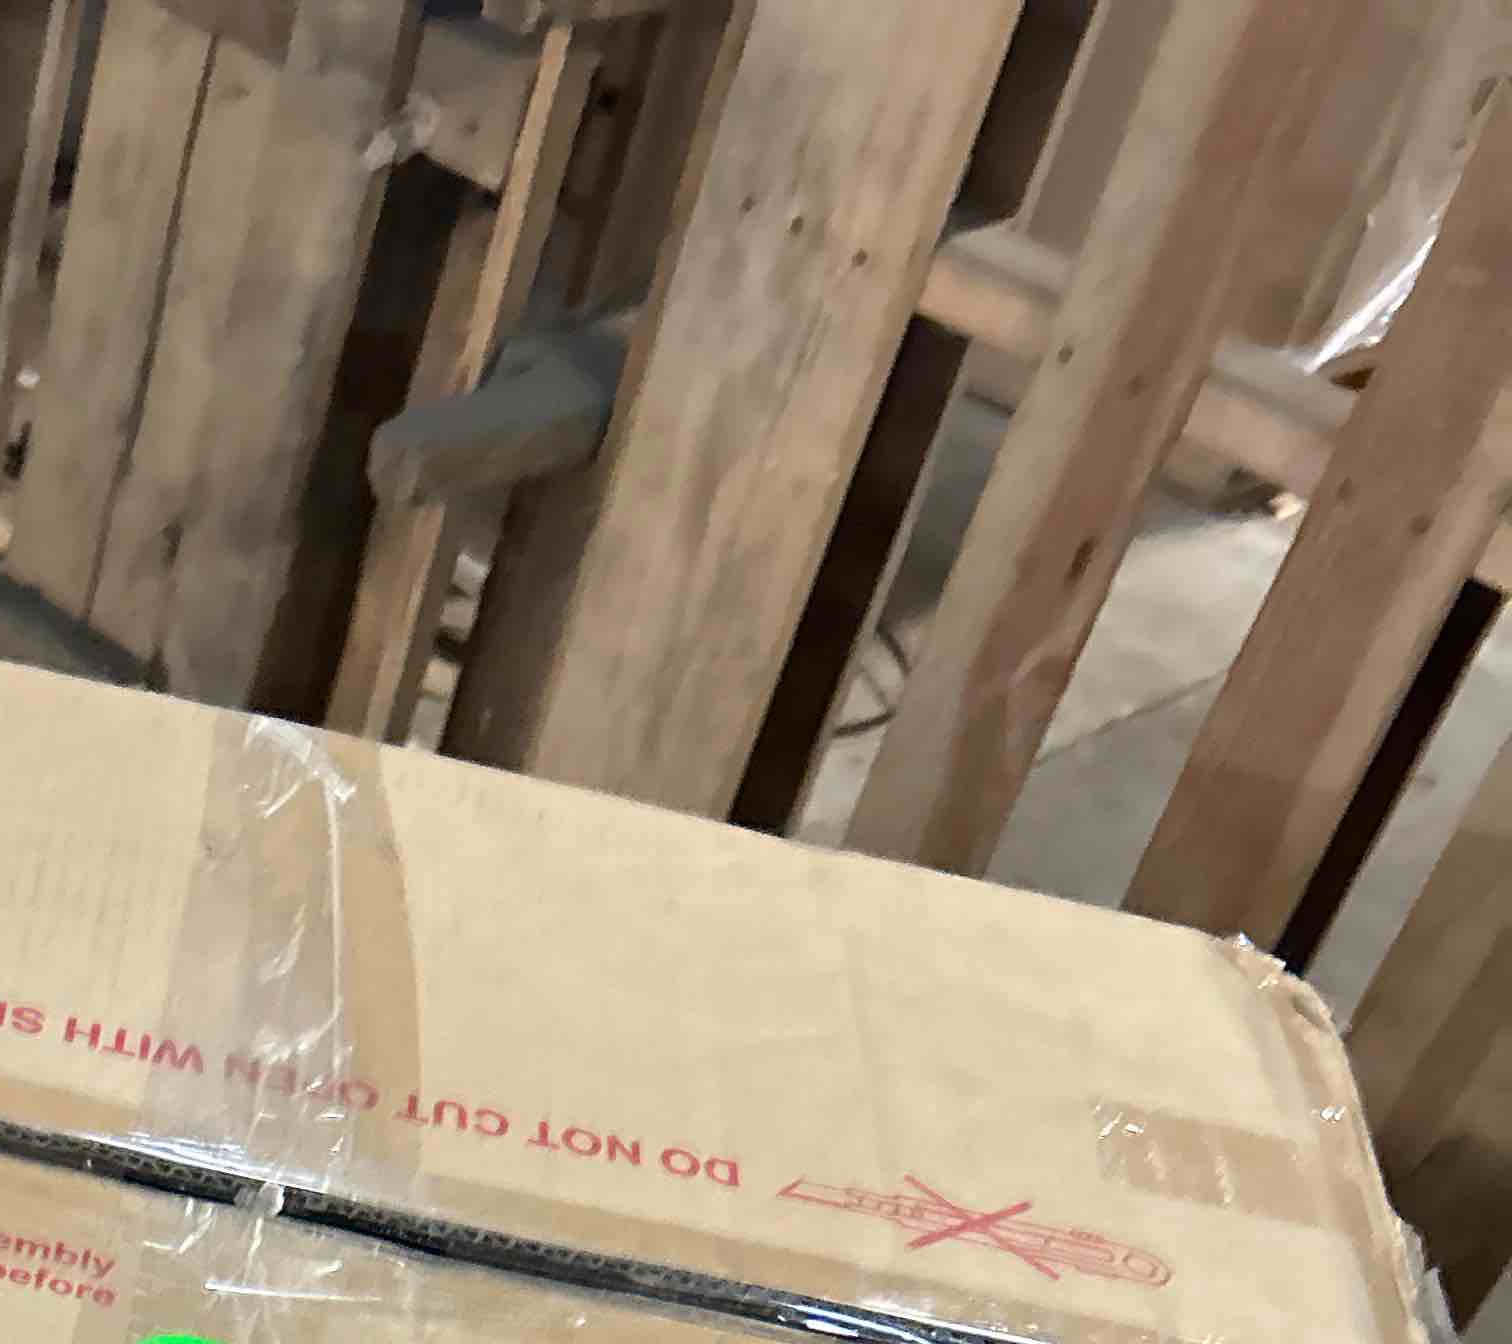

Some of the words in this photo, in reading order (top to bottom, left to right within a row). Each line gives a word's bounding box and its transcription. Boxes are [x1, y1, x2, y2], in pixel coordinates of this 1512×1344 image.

[64, 1016, 204, 1075] WITH
[396, 1091, 510, 1138] CUT
[526, 1120, 641, 1167] NOT
[660, 1146, 740, 1188] DO
